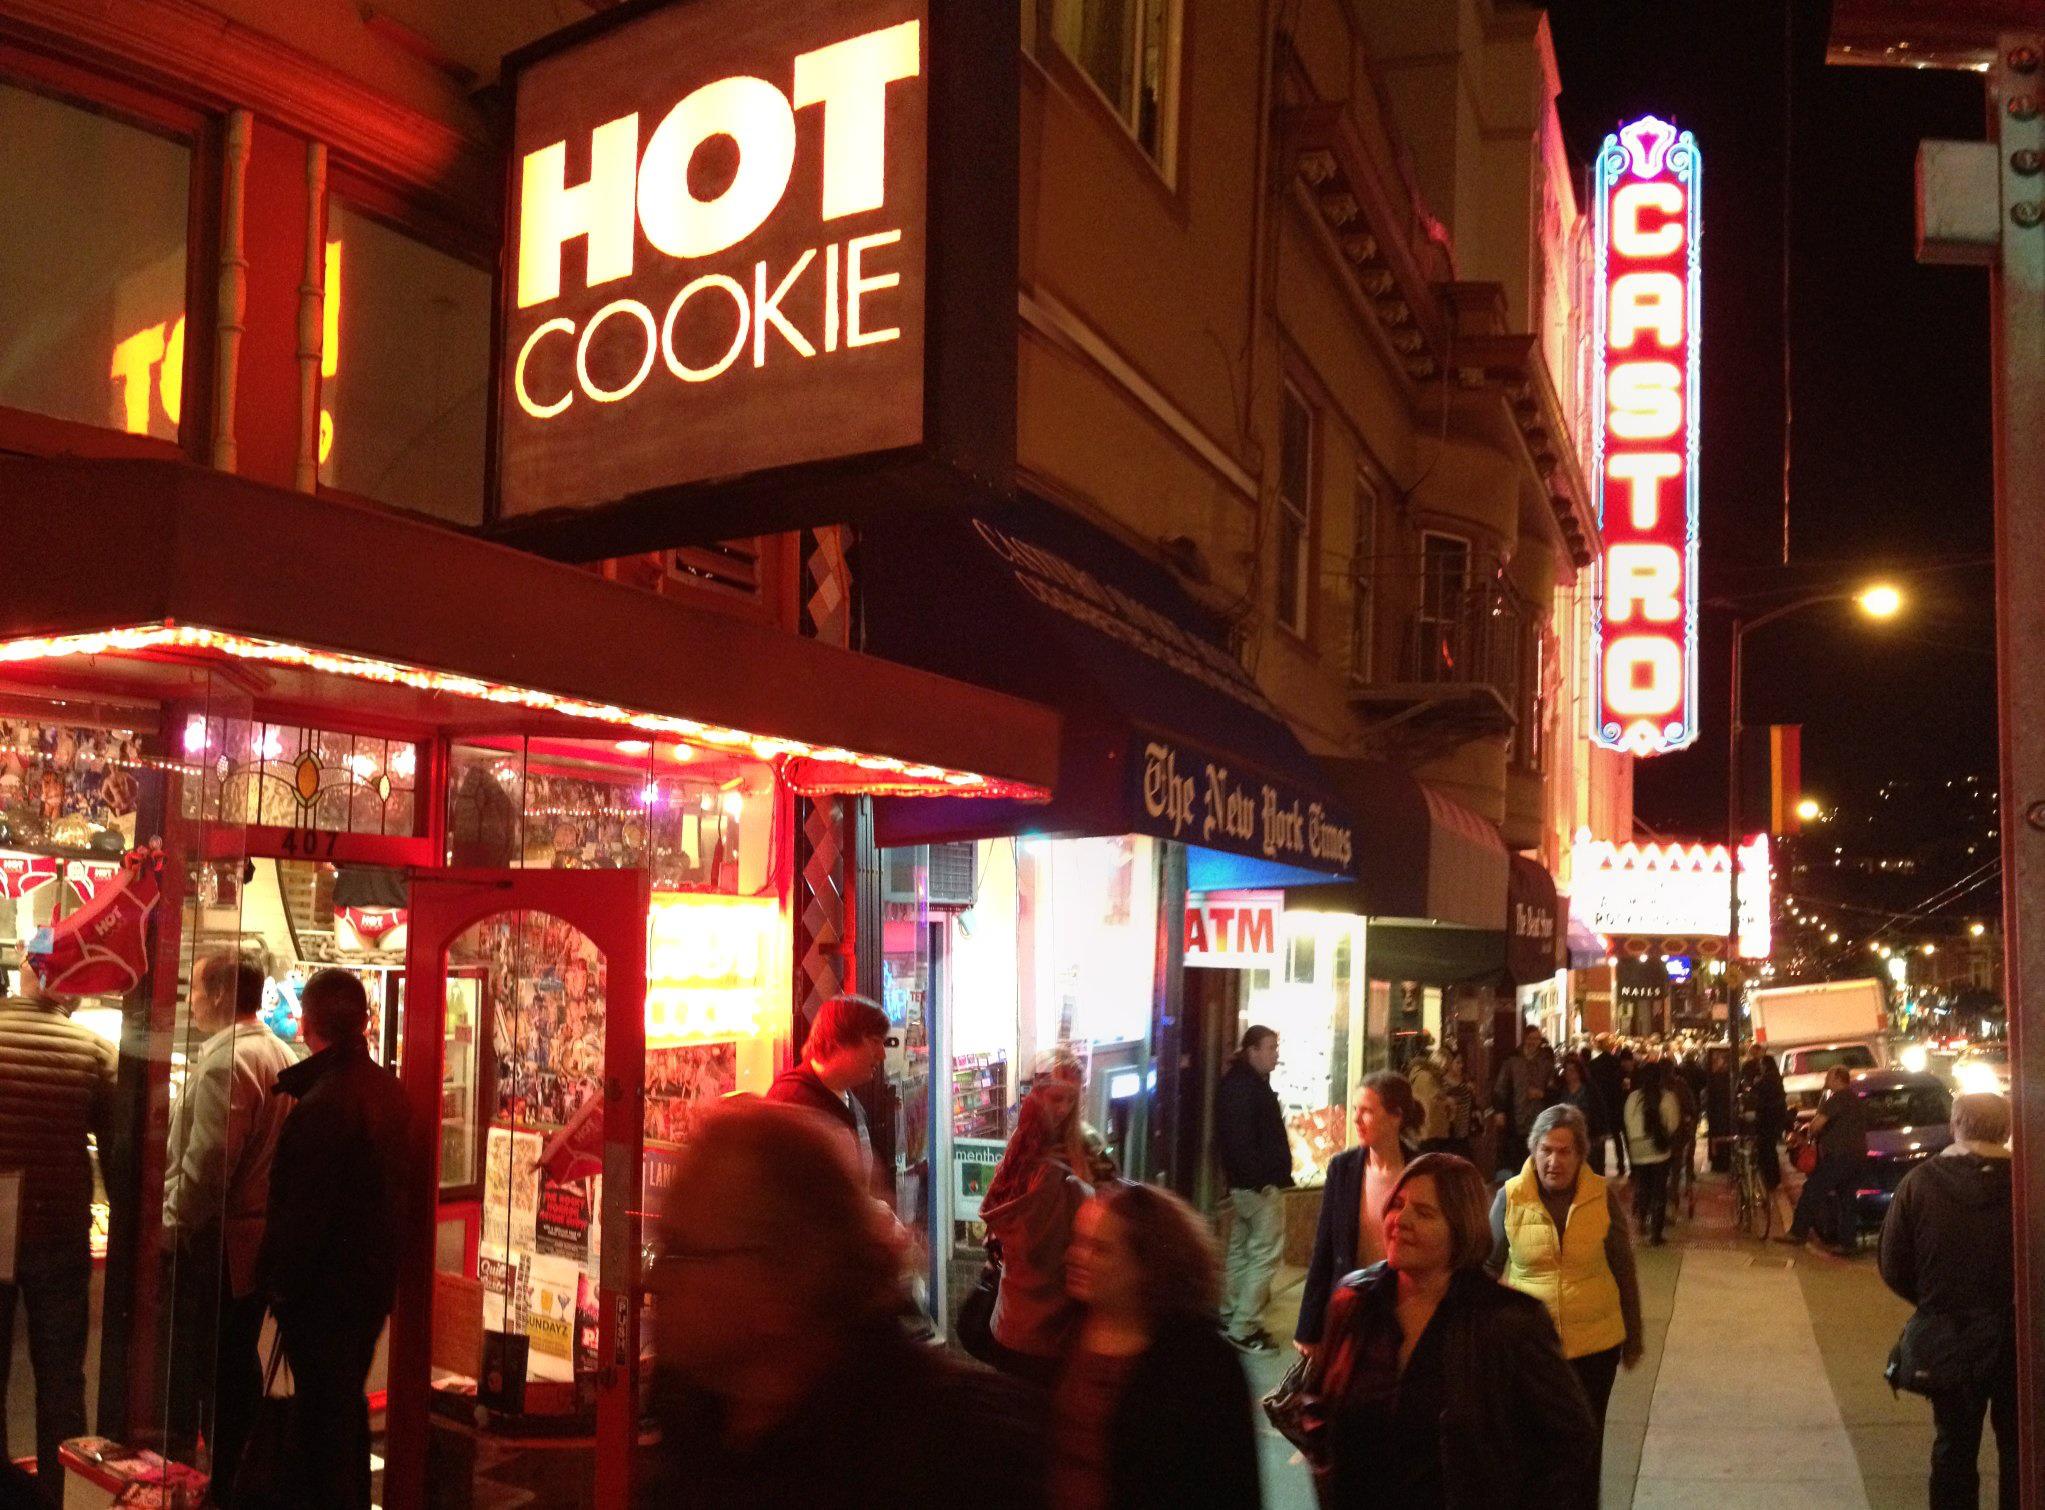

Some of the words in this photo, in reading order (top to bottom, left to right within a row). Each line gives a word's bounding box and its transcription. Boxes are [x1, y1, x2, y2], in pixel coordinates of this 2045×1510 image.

[518, 19, 920, 309] HOT
[515, 229, 901, 418] COOKIE
[1605, 180, 1684, 717] CASTRO
[1144, 742, 1195, 837] The
[1203, 763, 1255, 841] New
[1261, 784, 1304, 856] York
[1308, 802, 1352, 869] Times
[281, 830, 338, 857] 407
[94, 905, 122, 936] HOT
[361, 914, 384, 926] HOT
[1183, 908, 1274, 953] ATM
[1621, 986, 1661, 997] NAILS
[526, 1316, 569, 1337] UNDAYZ
